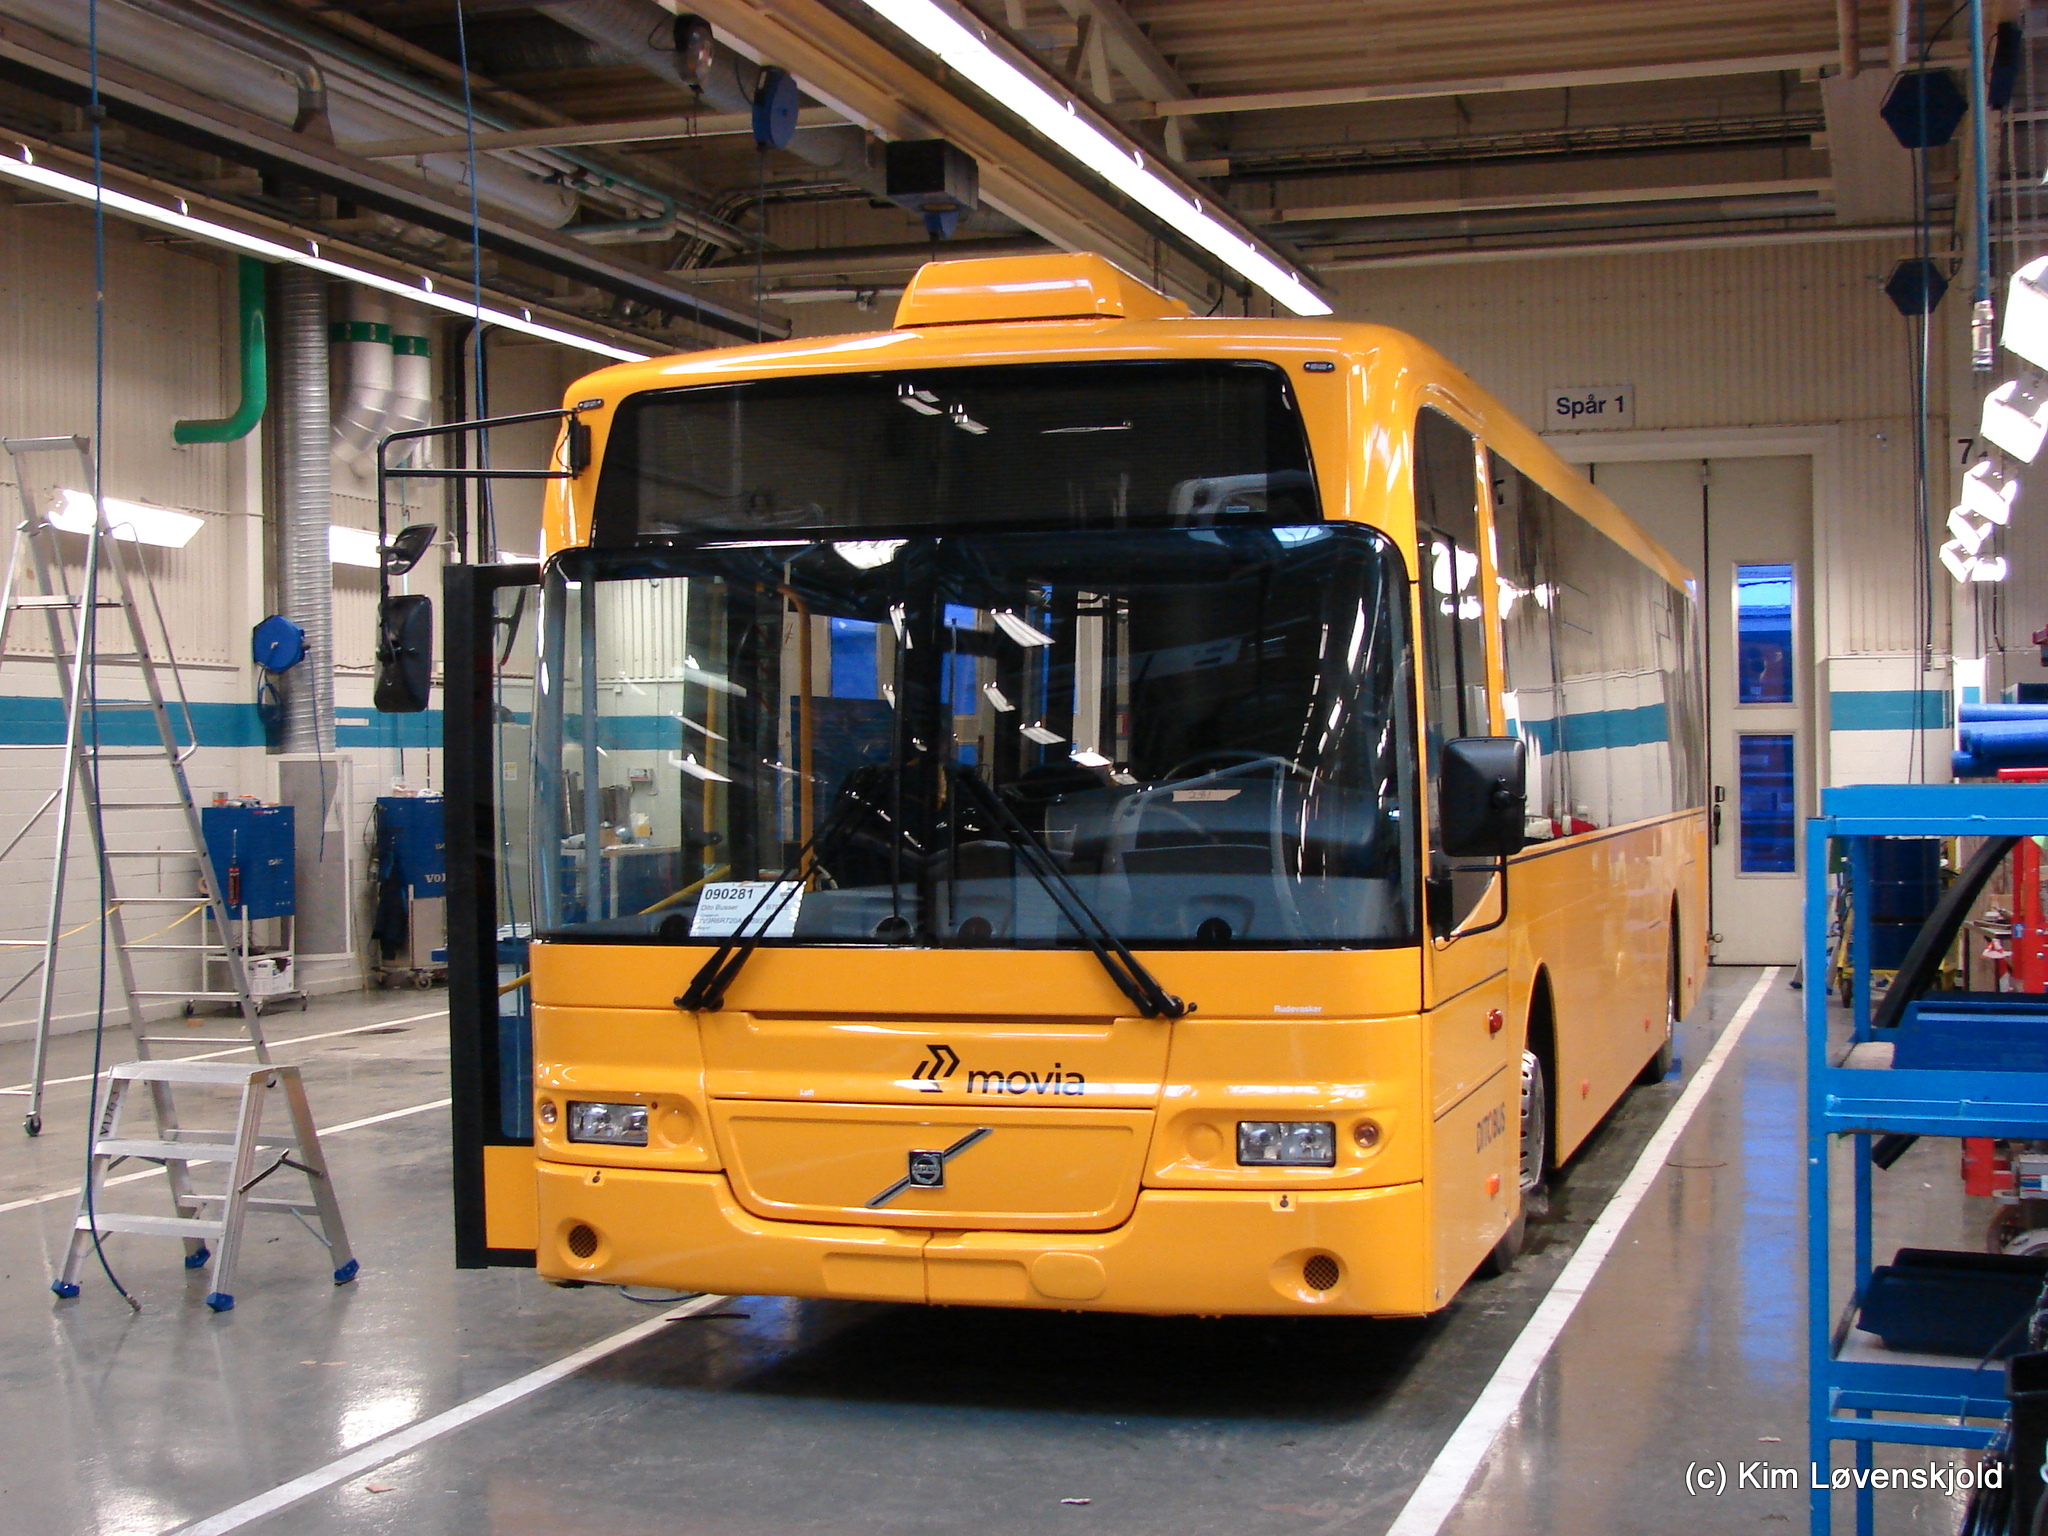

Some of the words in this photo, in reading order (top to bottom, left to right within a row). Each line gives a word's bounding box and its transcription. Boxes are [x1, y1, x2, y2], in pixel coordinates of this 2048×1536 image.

[1556, 393, 1607, 420] Spår
[1614, 395, 1624, 413] 1
[1957, 438, 1974, 465] 7
[705, 888, 754, 900] 090281
[967, 1062, 1086, 1096] movia
